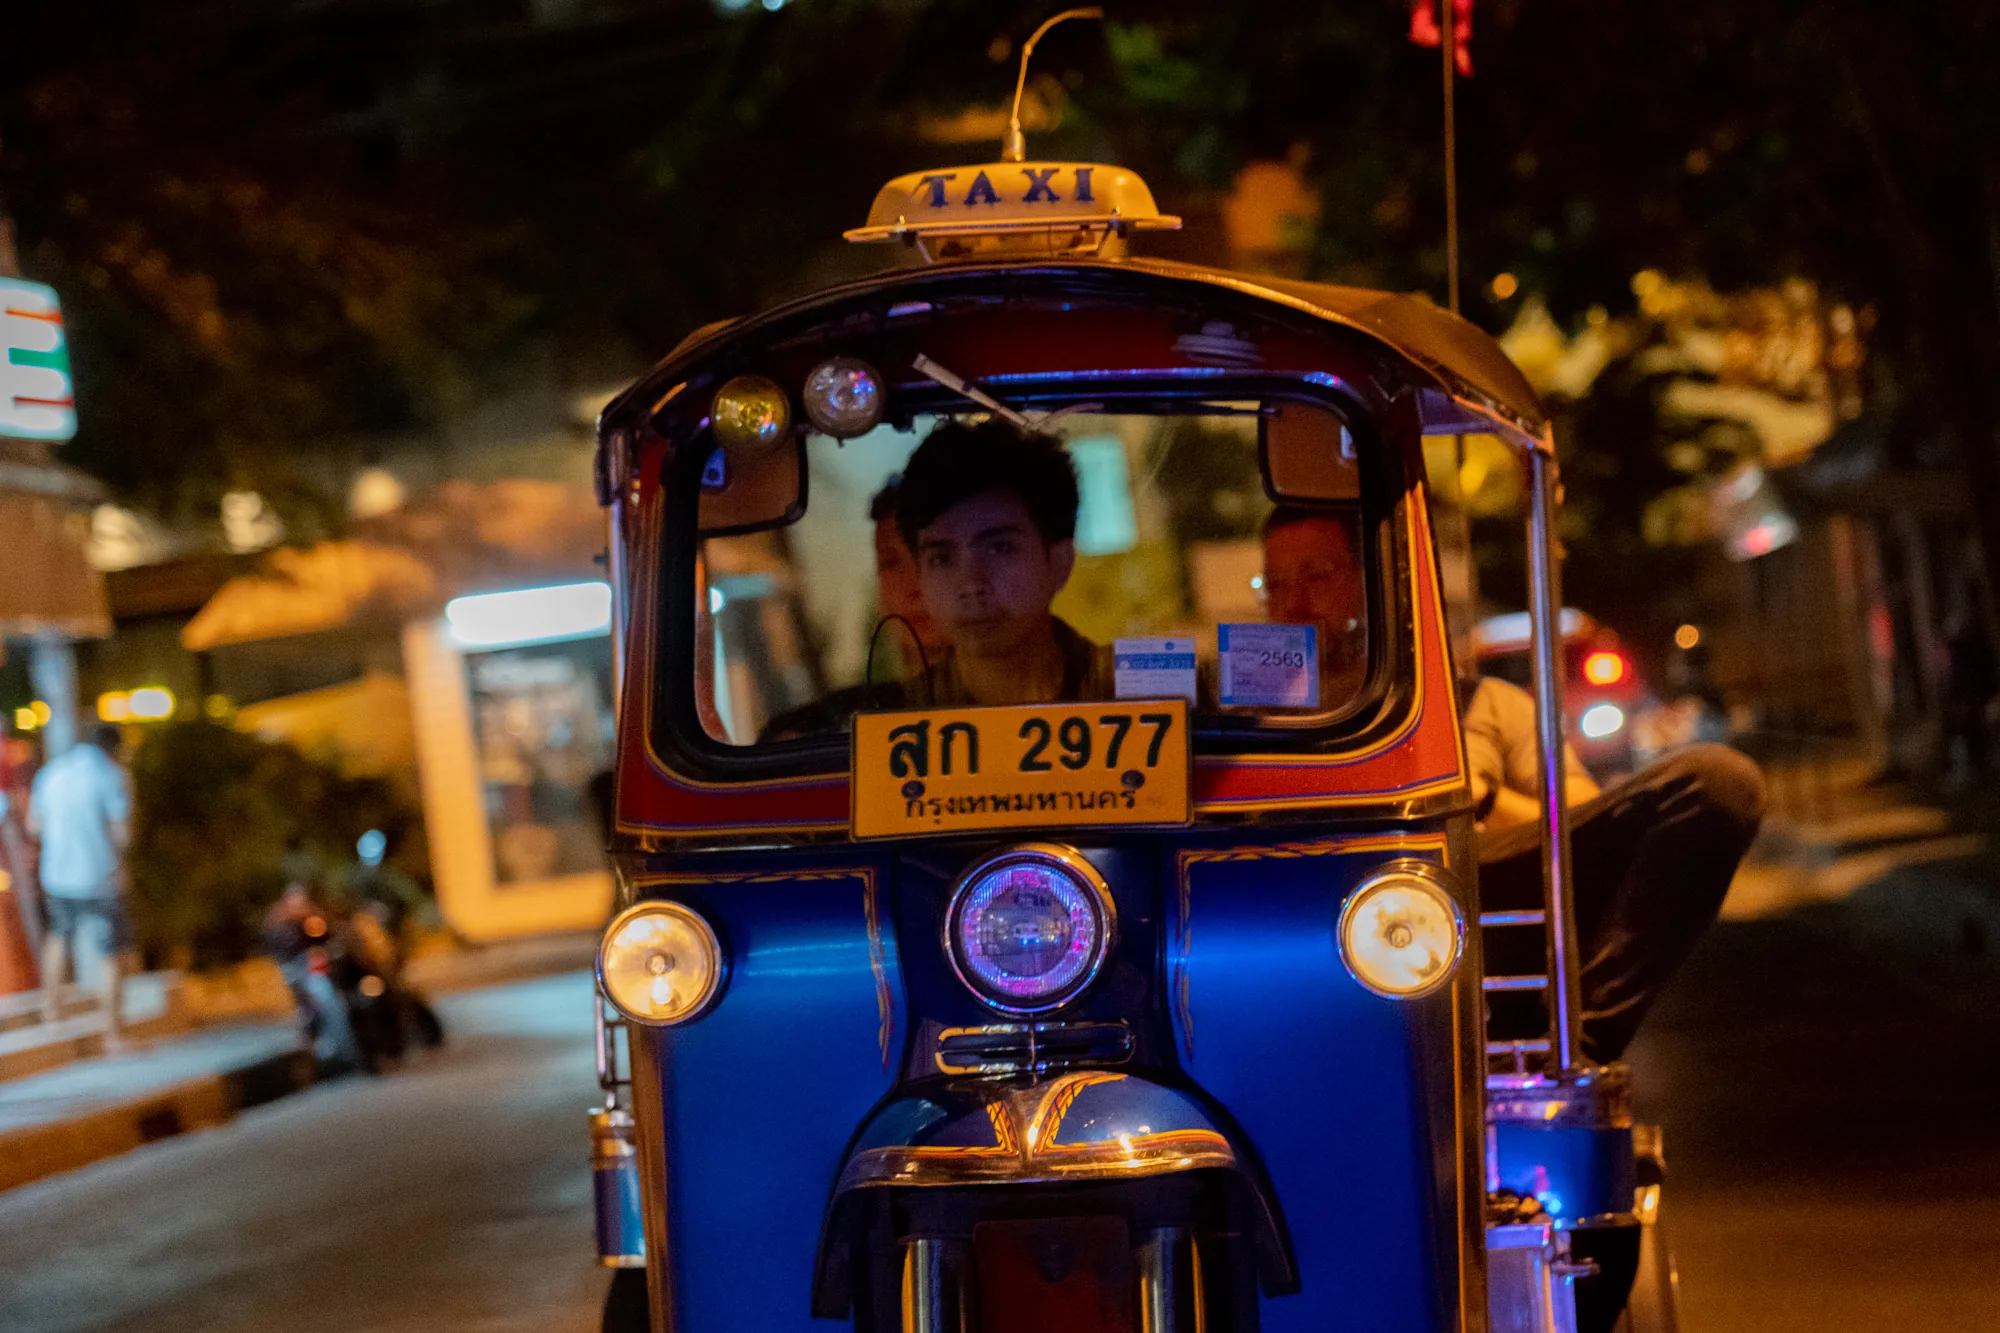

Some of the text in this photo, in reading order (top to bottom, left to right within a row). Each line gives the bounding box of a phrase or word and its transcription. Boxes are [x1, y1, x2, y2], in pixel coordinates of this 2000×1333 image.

[911, 167, 1095, 208] TAXI
[1260, 651, 1304, 668] 2563
[888, 714, 1173, 778] สก 2977
[905, 788, 1137, 824] กรุงเทพมหานคร
